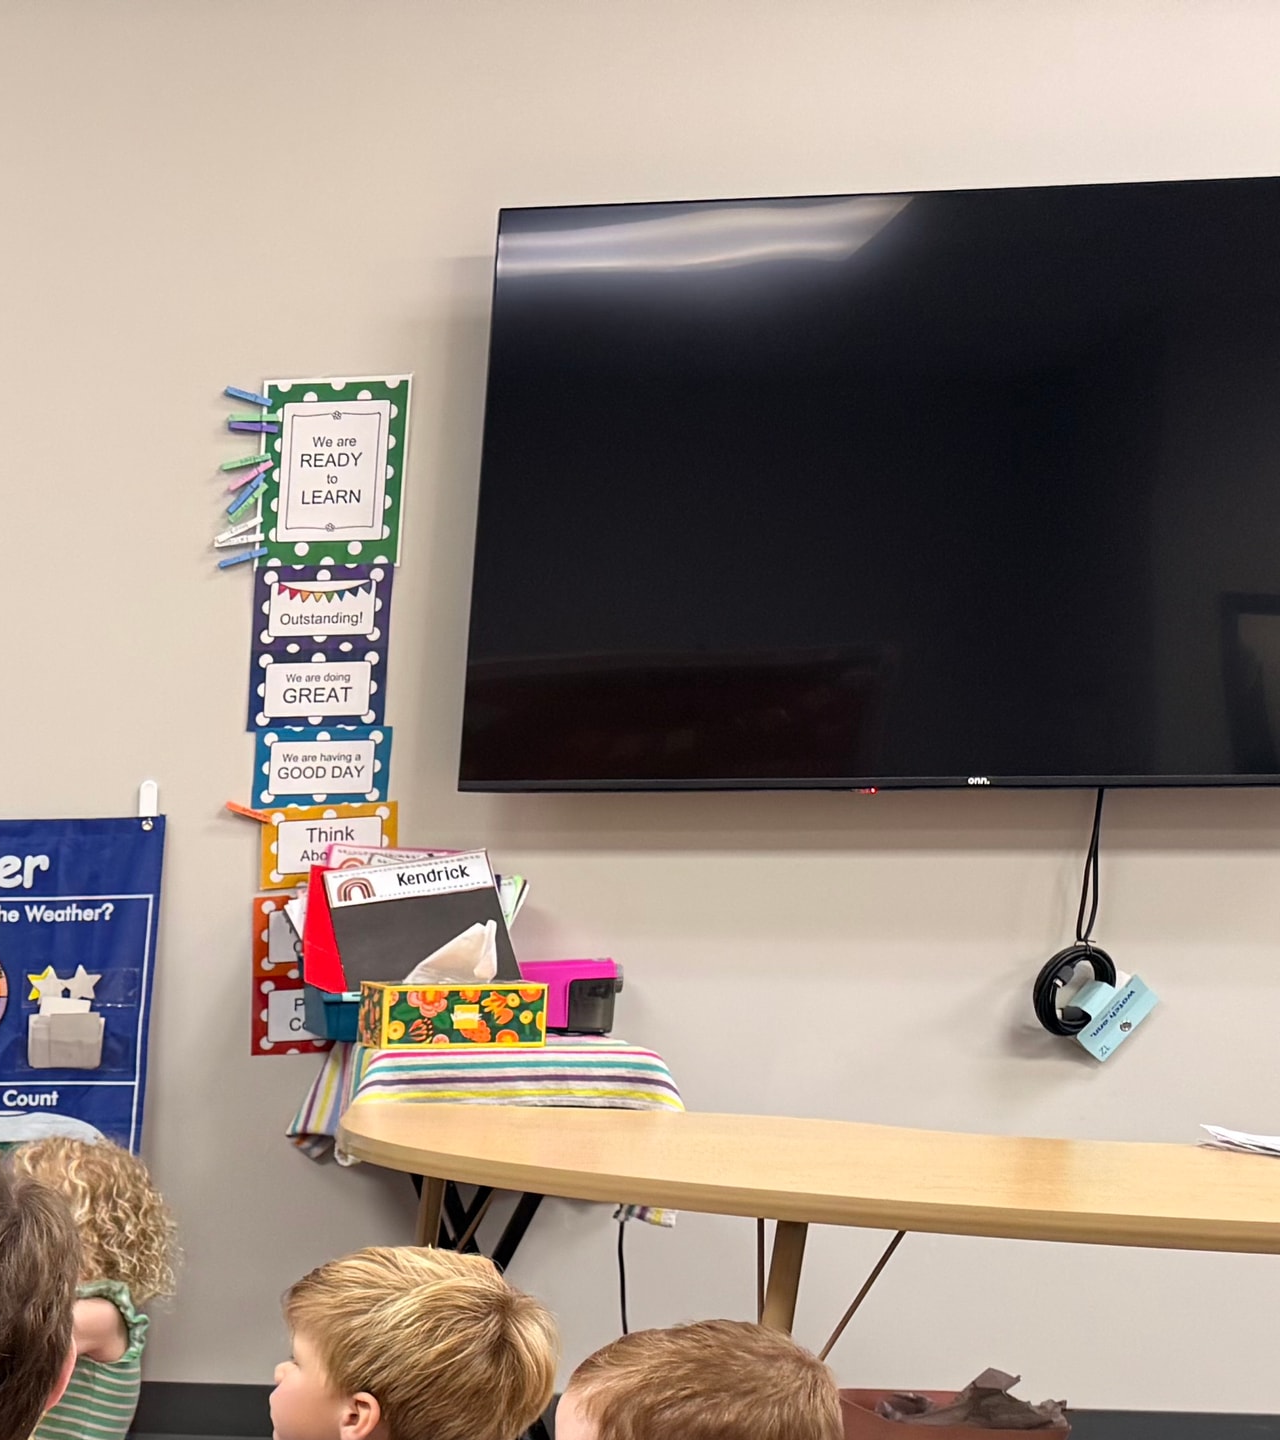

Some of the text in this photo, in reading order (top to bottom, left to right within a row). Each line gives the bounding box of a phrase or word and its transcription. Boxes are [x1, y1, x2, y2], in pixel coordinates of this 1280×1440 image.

[312, 436, 357, 448] We are
[300, 452, 363, 469] READY
[326, 474, 338, 485] to
[301, 489, 362, 505] LEARN
[280, 611, 364, 627] Outstanding!
[286, 672, 351, 685] We are doing
[282, 686, 353, 704] GREAT
[282, 752, 362, 765] We are having a
[277, 765, 365, 780] GOOD DAY
[967, 776, 991, 785] onn.
[306, 826, 355, 844] Think
[300, 849, 328, 862] Abo
[396, 864, 471, 888] Kendrick
[24, 902, 115, 923] Weather?
[3, 1088, 60, 1107] Count
